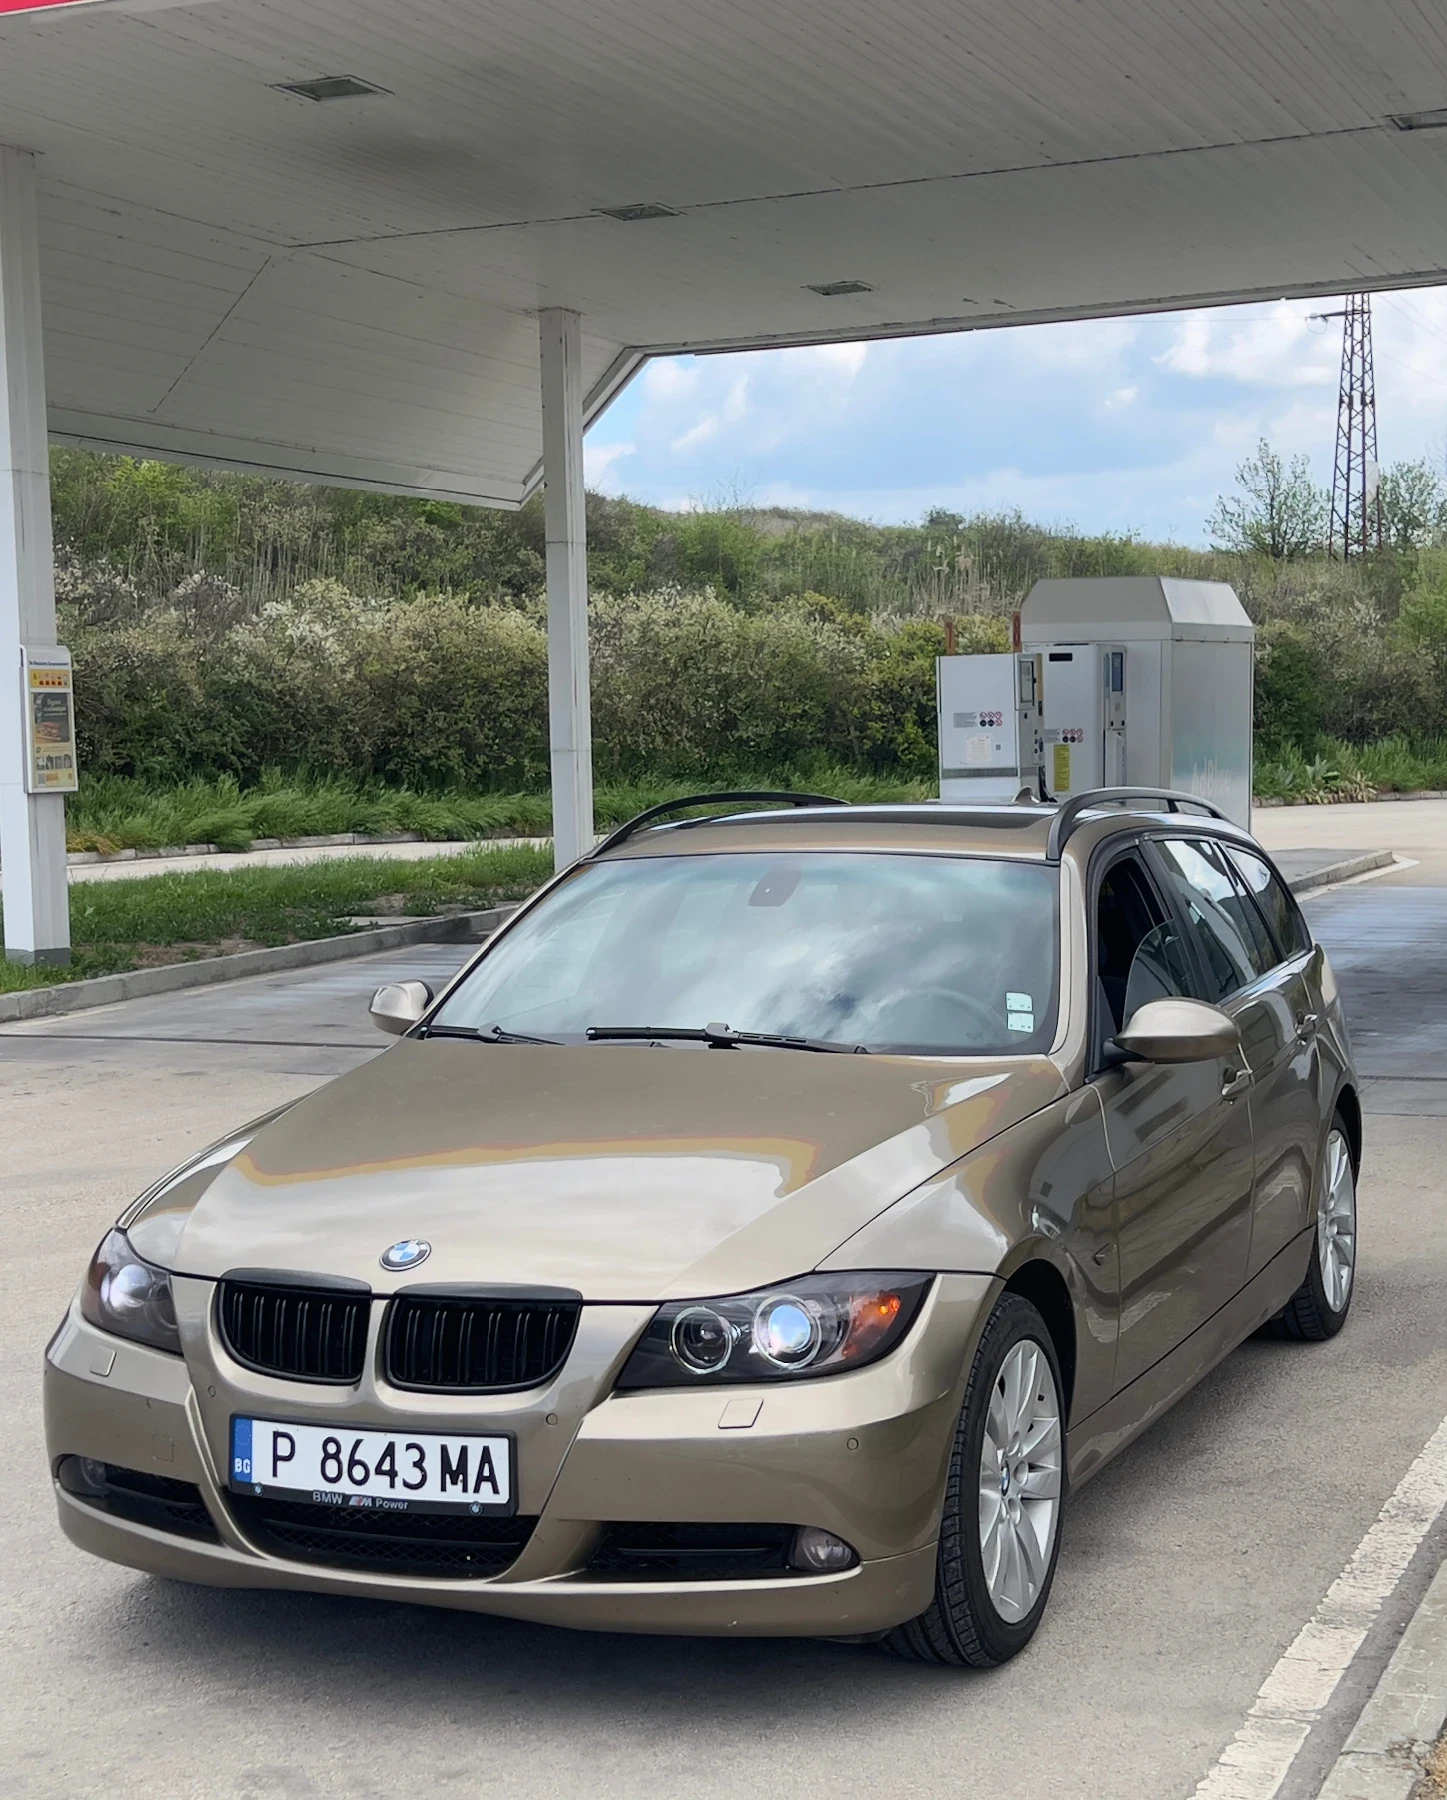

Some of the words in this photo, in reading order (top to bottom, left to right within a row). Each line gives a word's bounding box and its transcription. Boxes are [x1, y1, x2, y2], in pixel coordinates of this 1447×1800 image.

[234, 1457, 251, 1474] BG
[272, 1431, 296, 1478] P
[320, 1436, 427, 1491] 8643
[440, 1443, 500, 1495] MA
[312, 1491, 343, 1505] BMW
[375, 1497, 409, 1510] Power
